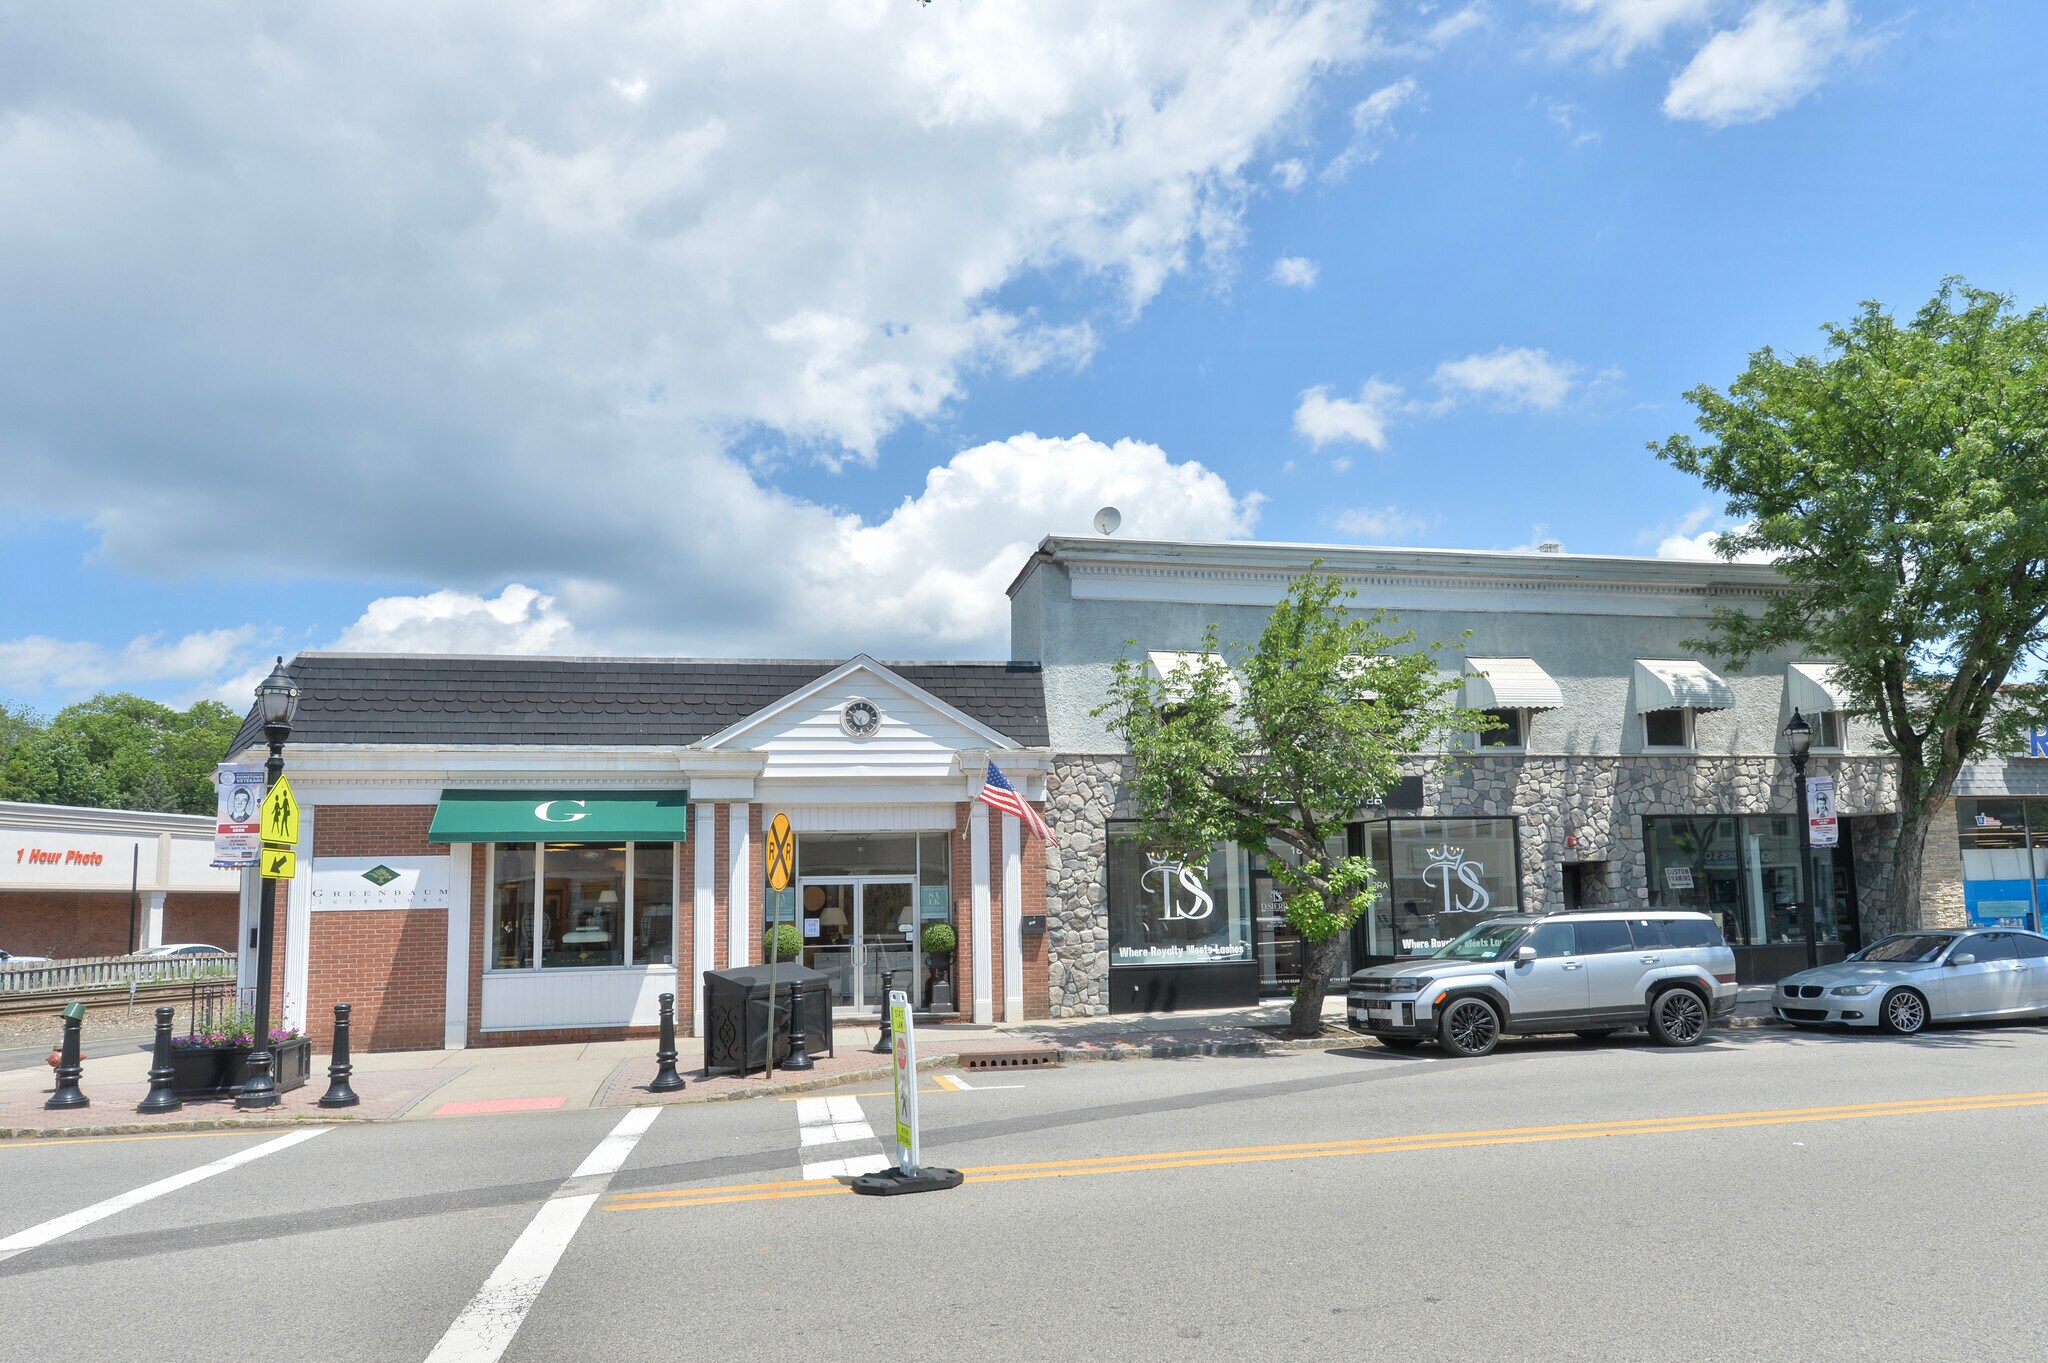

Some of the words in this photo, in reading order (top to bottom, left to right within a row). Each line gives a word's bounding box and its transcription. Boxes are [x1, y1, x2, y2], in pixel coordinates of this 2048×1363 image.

[534, 800, 592, 822] G
[17, 848, 24, 864] 1
[29, 849, 62, 865] Hour
[65, 849, 103, 867] Photo
[769, 842, 775, 860] R
[786, 843, 791, 860] R
[312, 889, 449, 898] GREENBAUM
[1119, 947, 1148, 957] Where
[1150, 945, 1184, 958] Royalty
[1186, 944, 1212, 954] Meets
[1215, 943, 1244, 954] Lashes
[1402, 938, 1429, 949] Where
